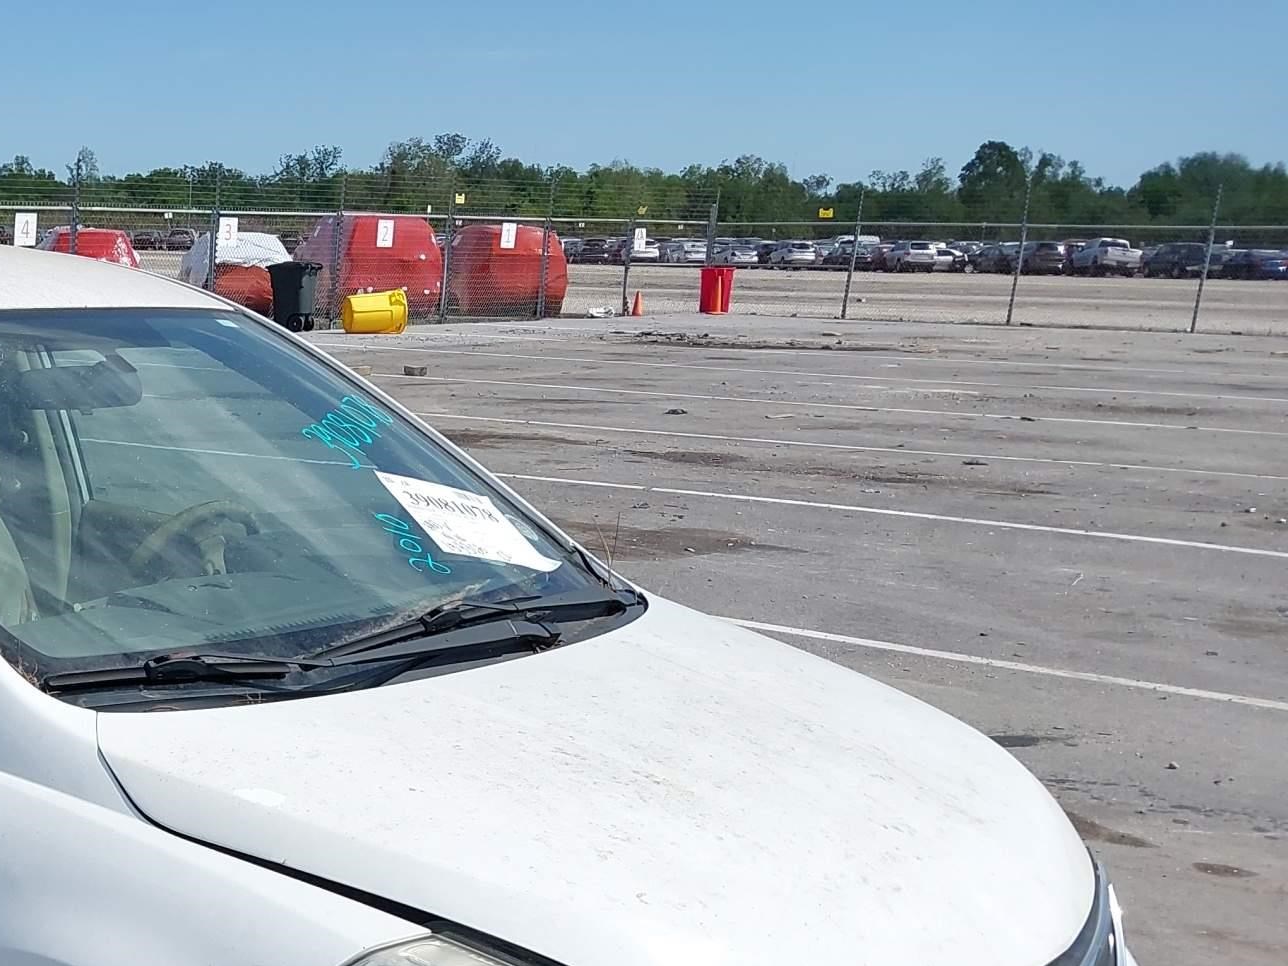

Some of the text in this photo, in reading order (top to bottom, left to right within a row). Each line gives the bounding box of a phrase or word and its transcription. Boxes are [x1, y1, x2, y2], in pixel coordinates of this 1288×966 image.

[20, 219, 31, 239] 4
[224, 223, 232, 241] 3
[381, 225, 389, 242] 2
[504, 228, 512, 244] 1
[401, 490, 500, 524] 39081078
[374, 513, 452, 575] 2010
